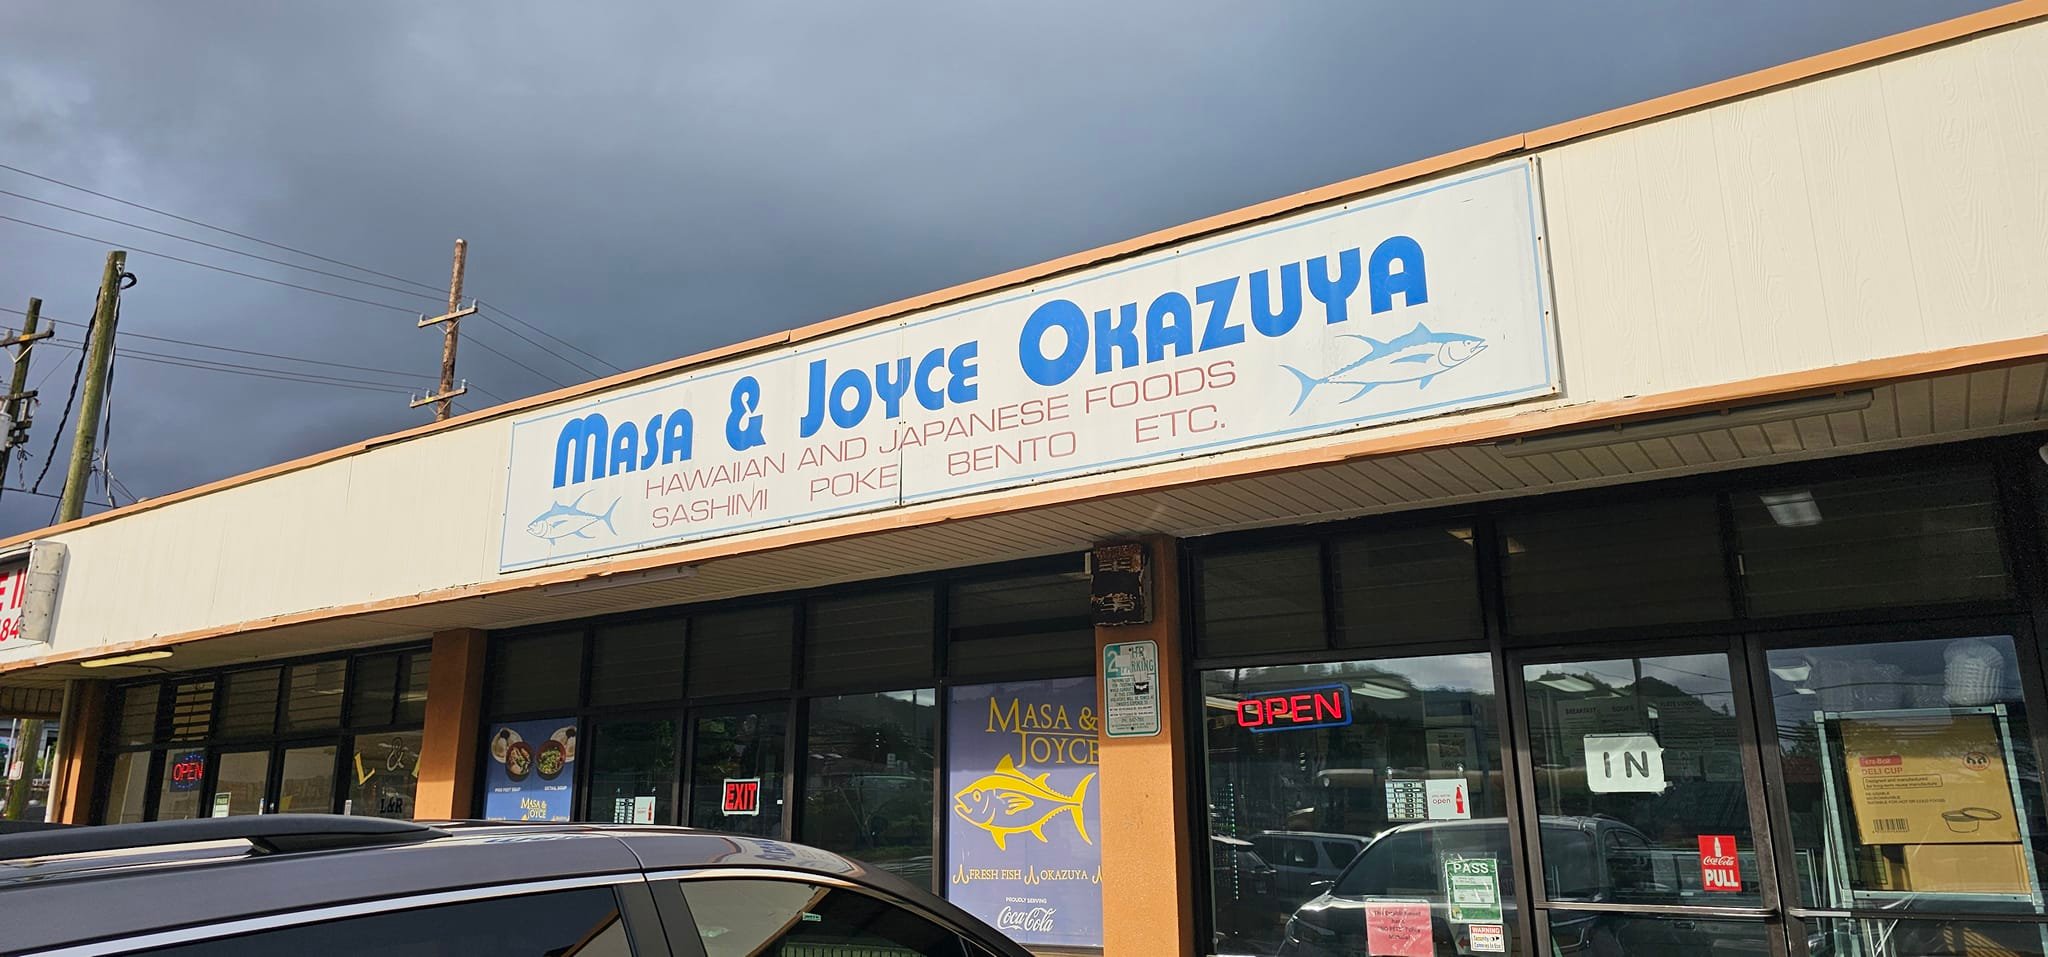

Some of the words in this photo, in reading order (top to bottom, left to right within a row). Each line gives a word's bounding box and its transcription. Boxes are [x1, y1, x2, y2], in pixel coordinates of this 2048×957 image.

[553, 408, 694, 489] MASA
[725, 375, 767, 452] &
[800, 340, 979, 438] JOYCE
[1018, 235, 1429, 387] OKAZUYA
[645, 453, 786, 499] HAWAIIAN
[797, 436, 868, 471] AND
[879, 394, 1070, 453] JAPANESE
[1085, 360, 1237, 415] FOODS
[651, 488, 769, 530] SASHIMI
[810, 464, 899, 502] POKE
[948, 431, 1077, 477] BENTO
[1135, 404, 1227, 444] ETC.
[1108, 650, 1119, 673] 2
[985, 696, 1070, 733] MASA
[1078, 706, 1098, 732] &
[1237, 691, 1343, 728] OPEN
[1017, 731, 1100, 768] JOYCE
[173, 761, 204, 781] OPEN
[1603, 750, 1650, 779] IN
[1884, 767, 1903, 775] CUP
[725, 783, 758, 811] EXIT
[969, 868, 999, 881] FRESH
[1001, 868, 1022, 881] FISH
[1040, 869, 1089, 881] OKAZUYA
[1453, 862, 1489, 873] PASS
[1704, 868, 1739, 887] PULL
[998, 905, 1057, 932] Coca-Cola
[1472, 927, 1500, 935] WARNING
